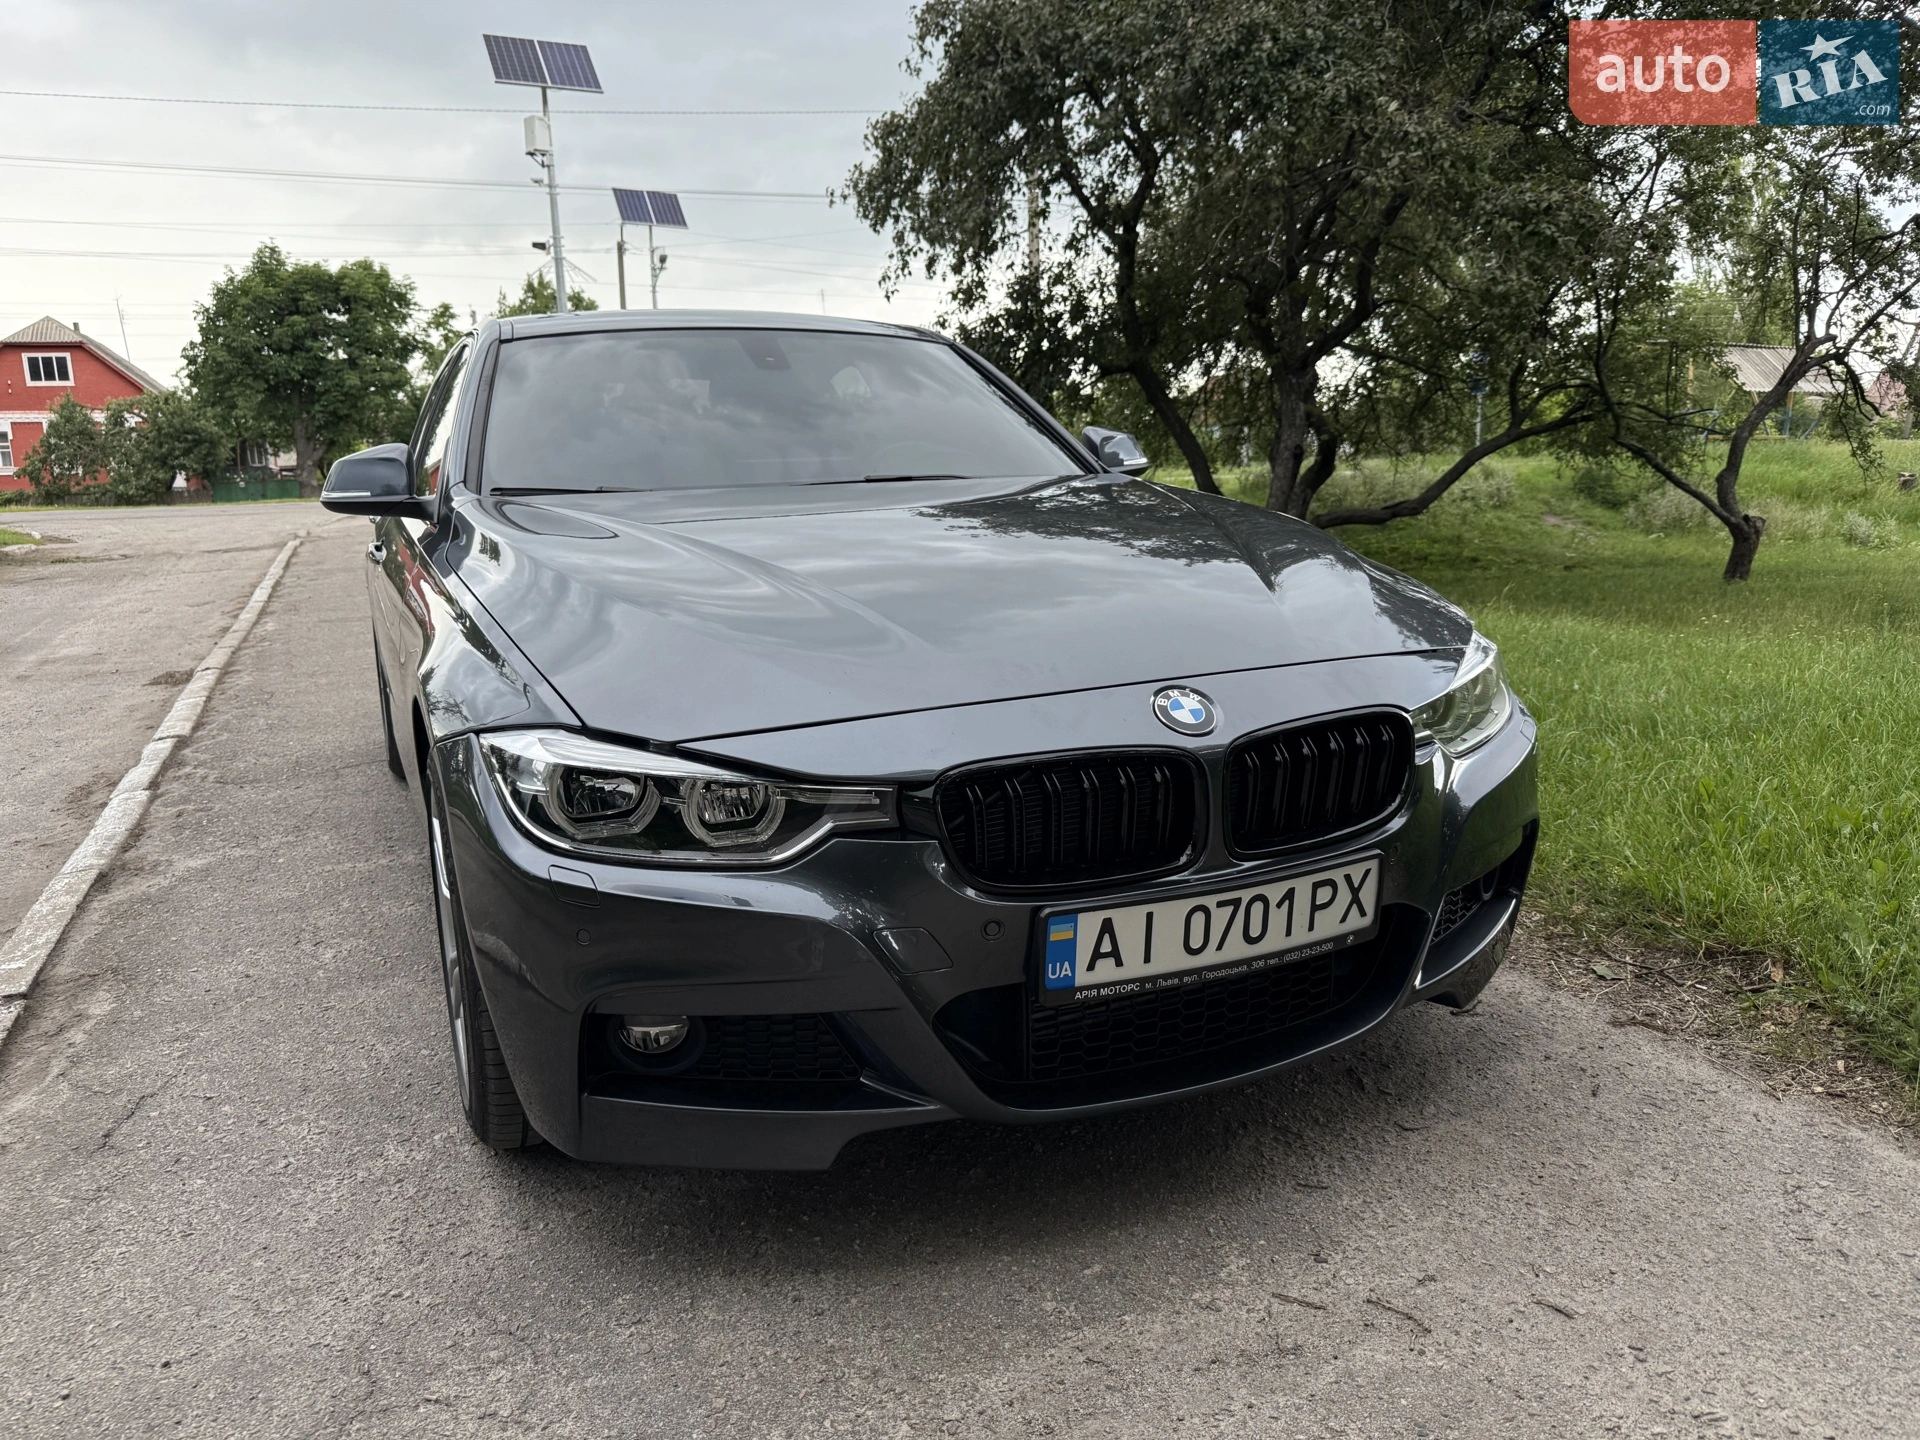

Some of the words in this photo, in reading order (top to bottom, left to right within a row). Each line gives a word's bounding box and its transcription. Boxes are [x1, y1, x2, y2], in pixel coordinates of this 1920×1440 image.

[1157, 689, 1202, 706] BMW
[1085, 911, 1155, 972] AI
[1182, 886, 1296, 956] 0701
[1307, 867, 1372, 933] PX
[1047, 961, 1073, 980] UA
[1074, 988, 1098, 1000] АРІЯ
[1099, 982, 1141, 996] МОТОРС
[1183, 974, 1200, 984] вул.
[1250, 958, 1266, 970] 306
[1283, 950, 1301, 963] (032)
[1301, 941, 1335, 957] 23-23-500
